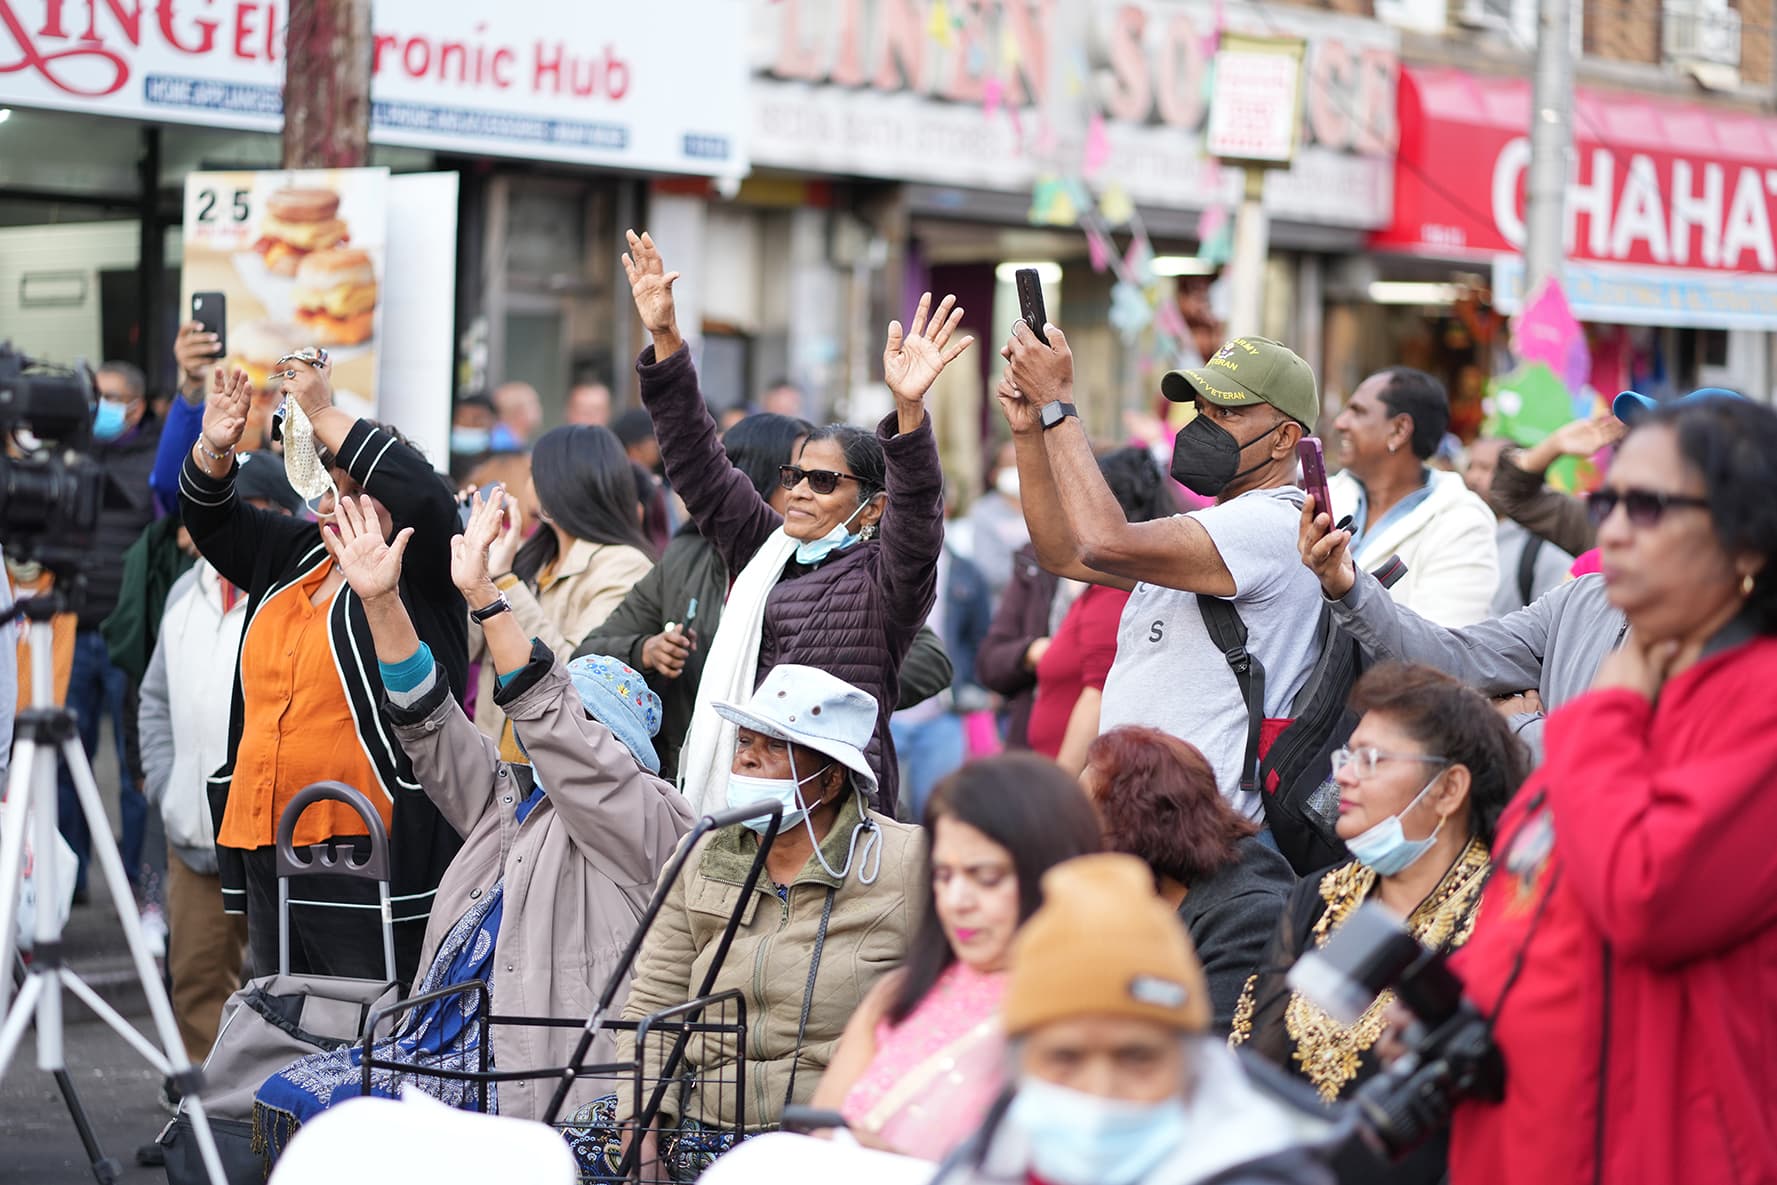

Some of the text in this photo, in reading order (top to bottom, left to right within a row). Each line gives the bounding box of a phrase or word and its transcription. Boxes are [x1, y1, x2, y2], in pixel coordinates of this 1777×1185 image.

[234, 3, 516, 88] Elronic
[532, 41, 630, 101] Hub
[1106, 5, 1397, 155] SOCE
[198, 188, 250, 222] 2 5
[1205, 383, 1246, 400] VETERAN
[1148, 619, 1165, 643] S
